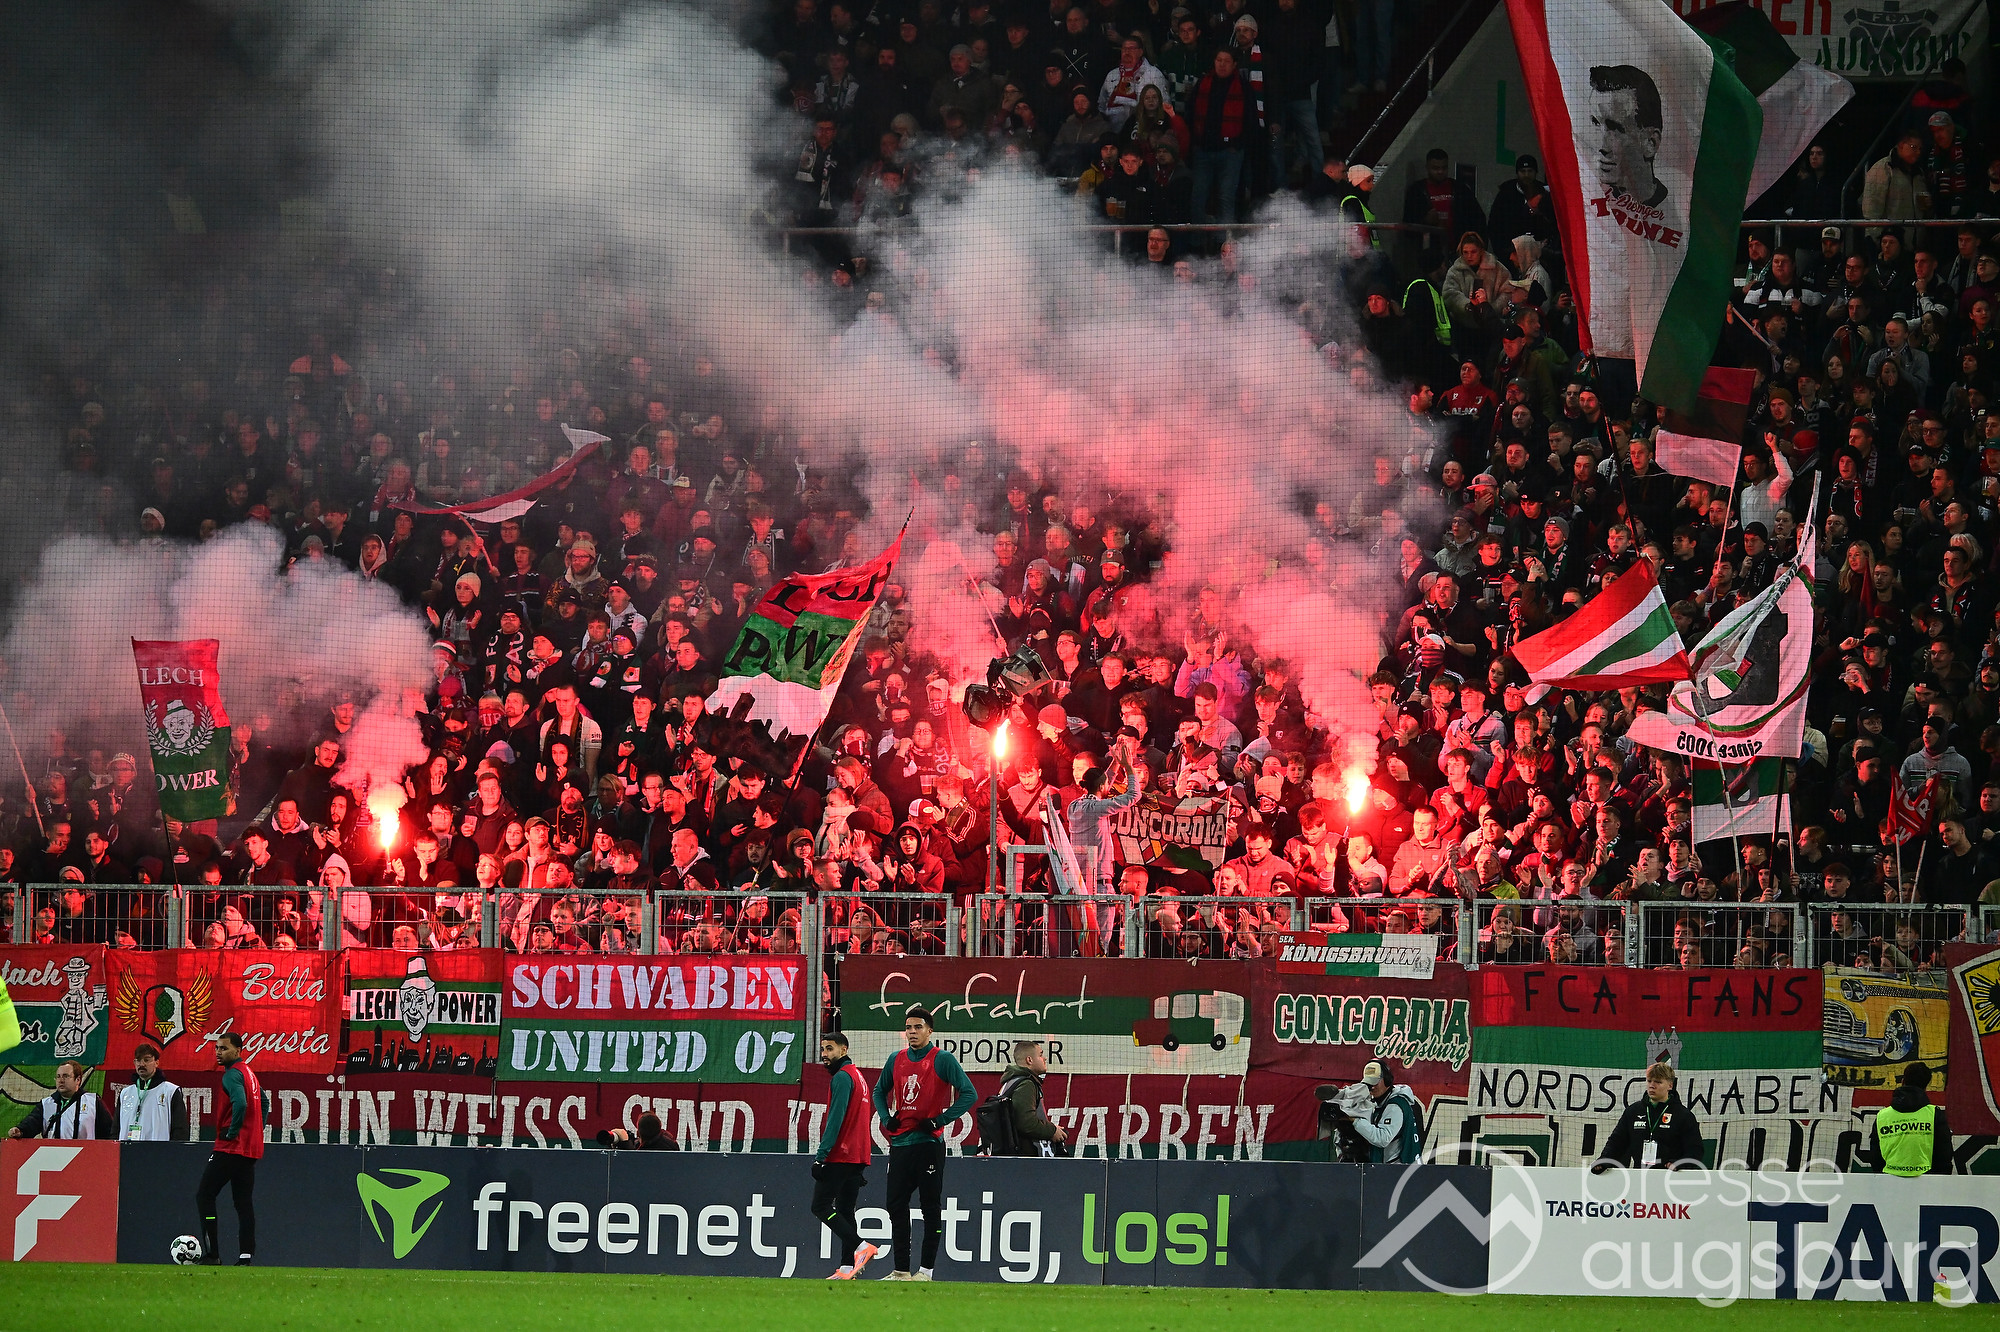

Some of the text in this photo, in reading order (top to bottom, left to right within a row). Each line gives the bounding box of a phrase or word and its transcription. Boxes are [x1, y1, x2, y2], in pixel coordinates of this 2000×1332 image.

[1872, 13, 1911, 23] FCA
[140, 667, 205, 686] LECH
[155, 769, 220, 791] OWER
[1279, 943, 1421, 966] KÖNIGSBRUNN
[242, 963, 327, 1001] Bella
[511, 963, 799, 1011] SCHWABEN
[1687, 975, 1809, 1017] FANS
[354, 990, 498, 1024] LECH POWER
[1273, 993, 1471, 1045] CONCORDIA
[510, 1028, 796, 1075] UNITED 07
[1374, 1031, 1471, 1073] Augsburg
[264, 1075, 396, 1146] RÜN
[1478, 1068, 1839, 1114] NORDSCWABEN
[1894, 1122, 1932, 1133] POWER
[473, 1182, 1230, 1284] freenet, etig, los!
[1747, 1201, 2000, 1302] TAR
